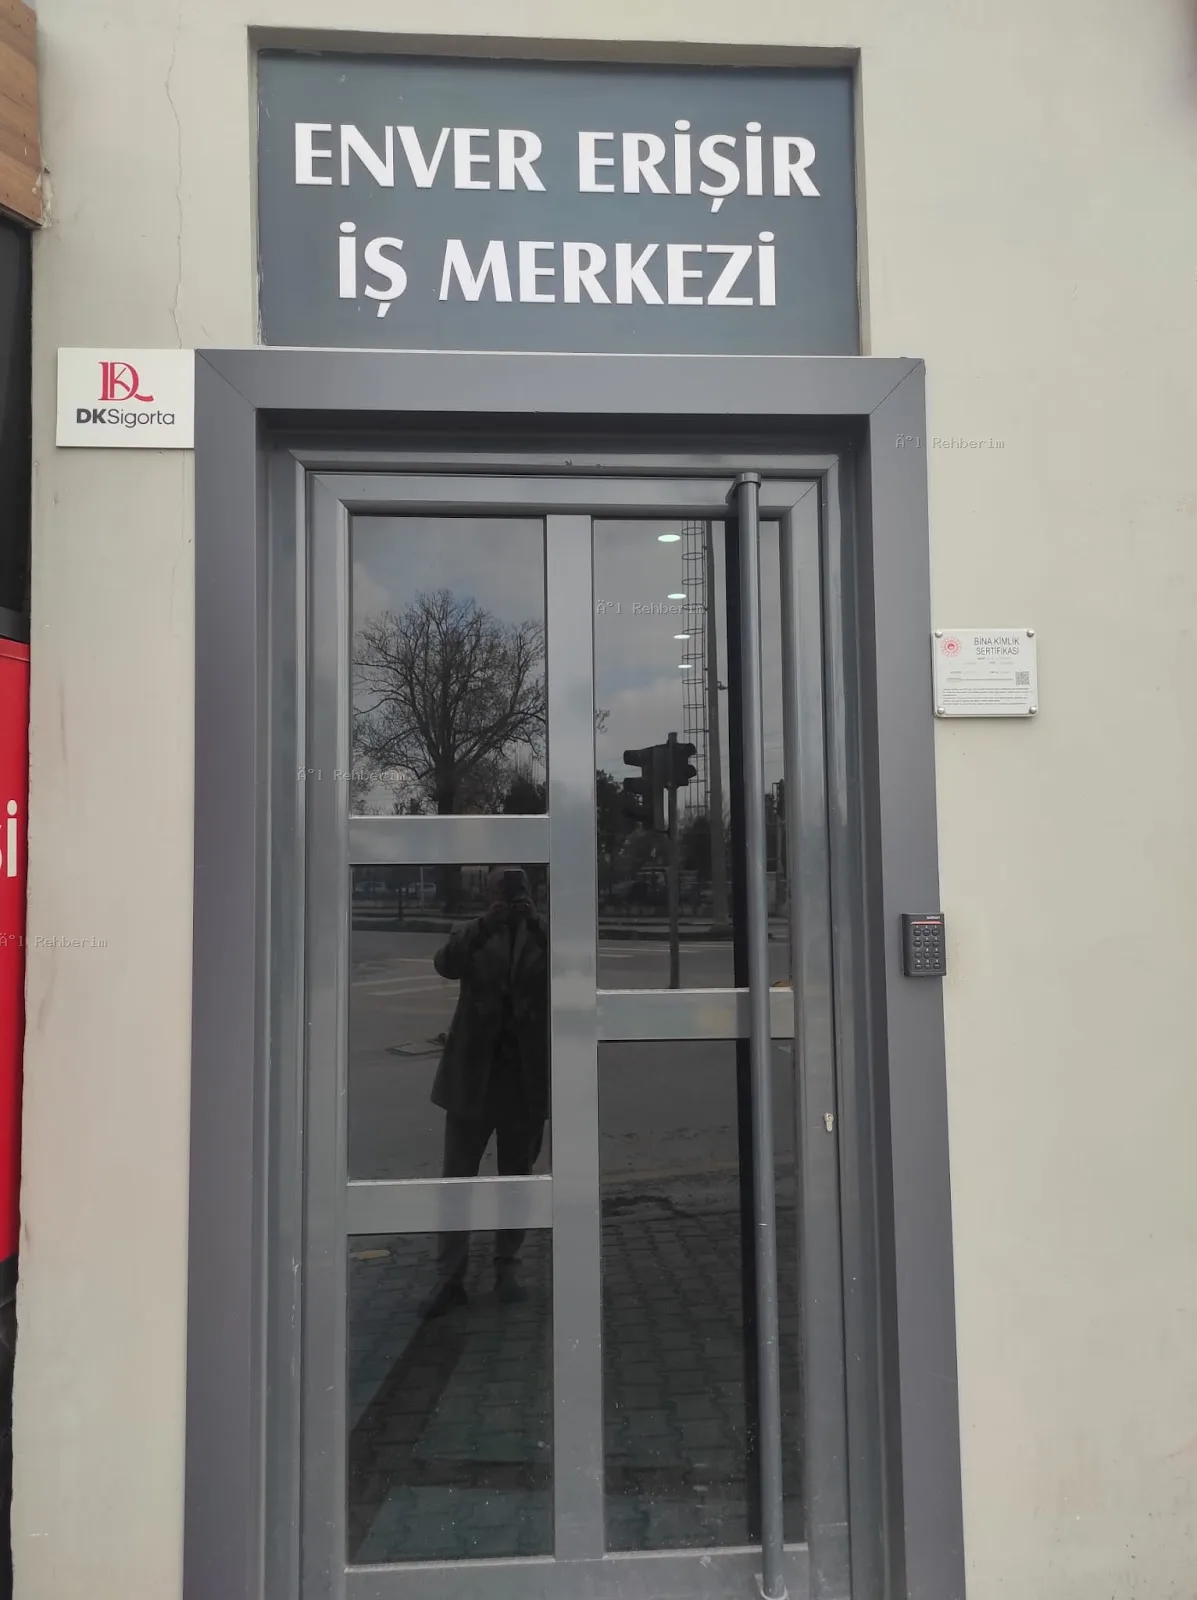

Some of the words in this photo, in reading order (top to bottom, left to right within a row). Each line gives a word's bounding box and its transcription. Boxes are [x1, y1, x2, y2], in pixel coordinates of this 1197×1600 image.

[295, 122, 547, 193] ENVER
[579, 119, 821, 213] ERİŞİR
[338, 221, 408, 319] İŞ
[438, 231, 776, 307] MERKEZİ
[76, 408, 175, 428] DKSigorta
[973, 637, 993, 646] BİNA
[993, 637, 1020, 646] KİMLİK
